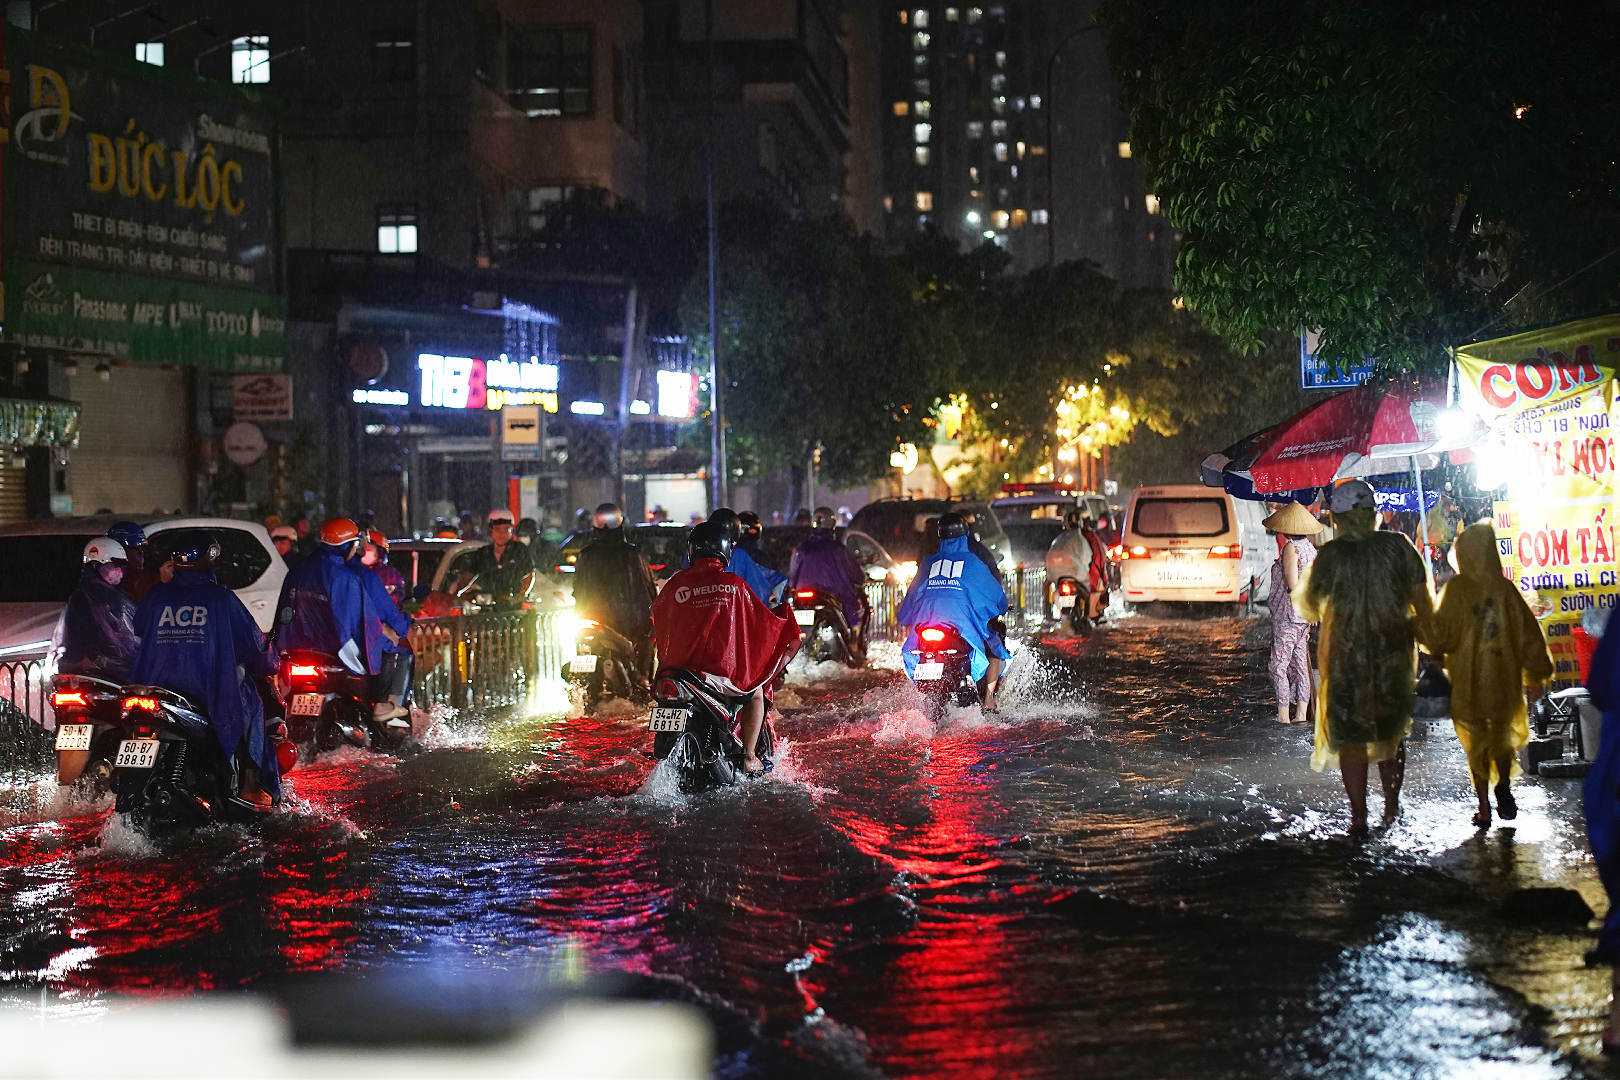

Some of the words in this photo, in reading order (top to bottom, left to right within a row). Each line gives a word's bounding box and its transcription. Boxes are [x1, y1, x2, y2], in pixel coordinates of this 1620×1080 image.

[87, 118, 167, 201] ĐỨC
[173, 143, 245, 223] LỘC
[205, 310, 248, 336] TOTO
[1480, 344, 1603, 409] CƠM
[1374, 492, 1407, 506] PSI
[1518, 523, 1570, 568] CƠM
[1560, 591, 1594, 612] SƯỜN
[158, 605, 208, 627] ACB
[653, 719, 681, 731] 6815
